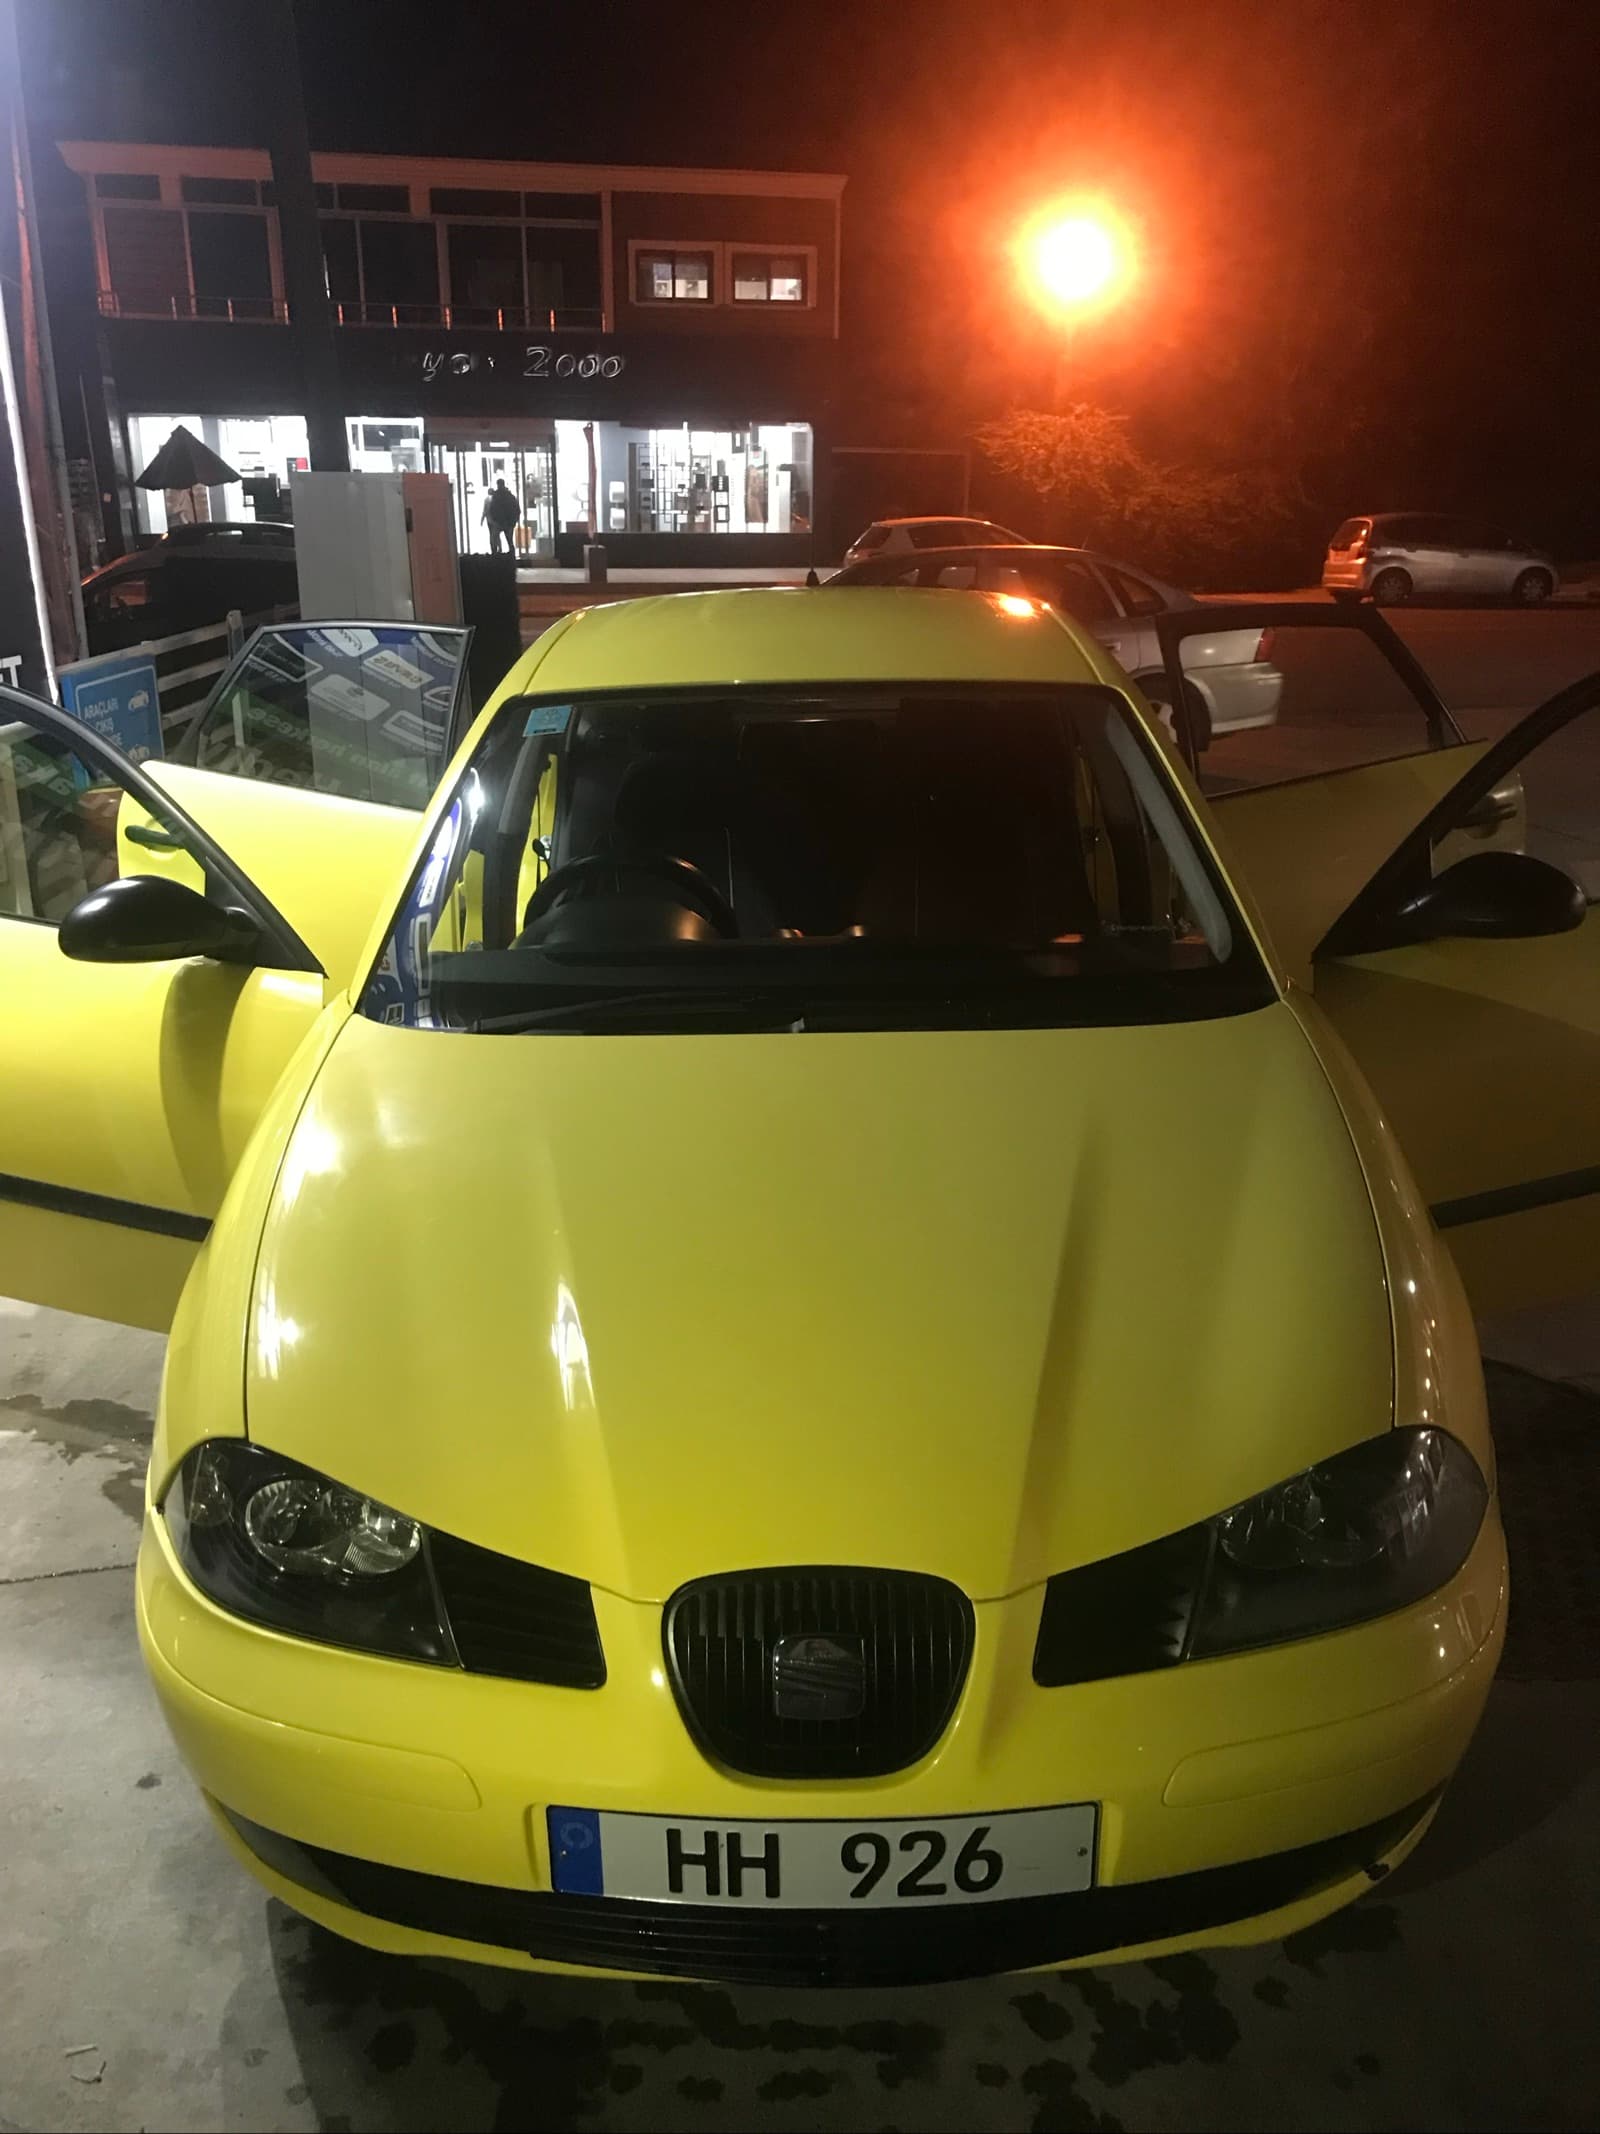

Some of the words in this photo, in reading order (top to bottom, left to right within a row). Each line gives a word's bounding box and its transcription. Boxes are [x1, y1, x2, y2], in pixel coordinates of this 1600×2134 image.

[523, 346, 625, 378] 2000
[666, 1828, 780, 1898] HH
[841, 1827, 1004, 1898] 926
